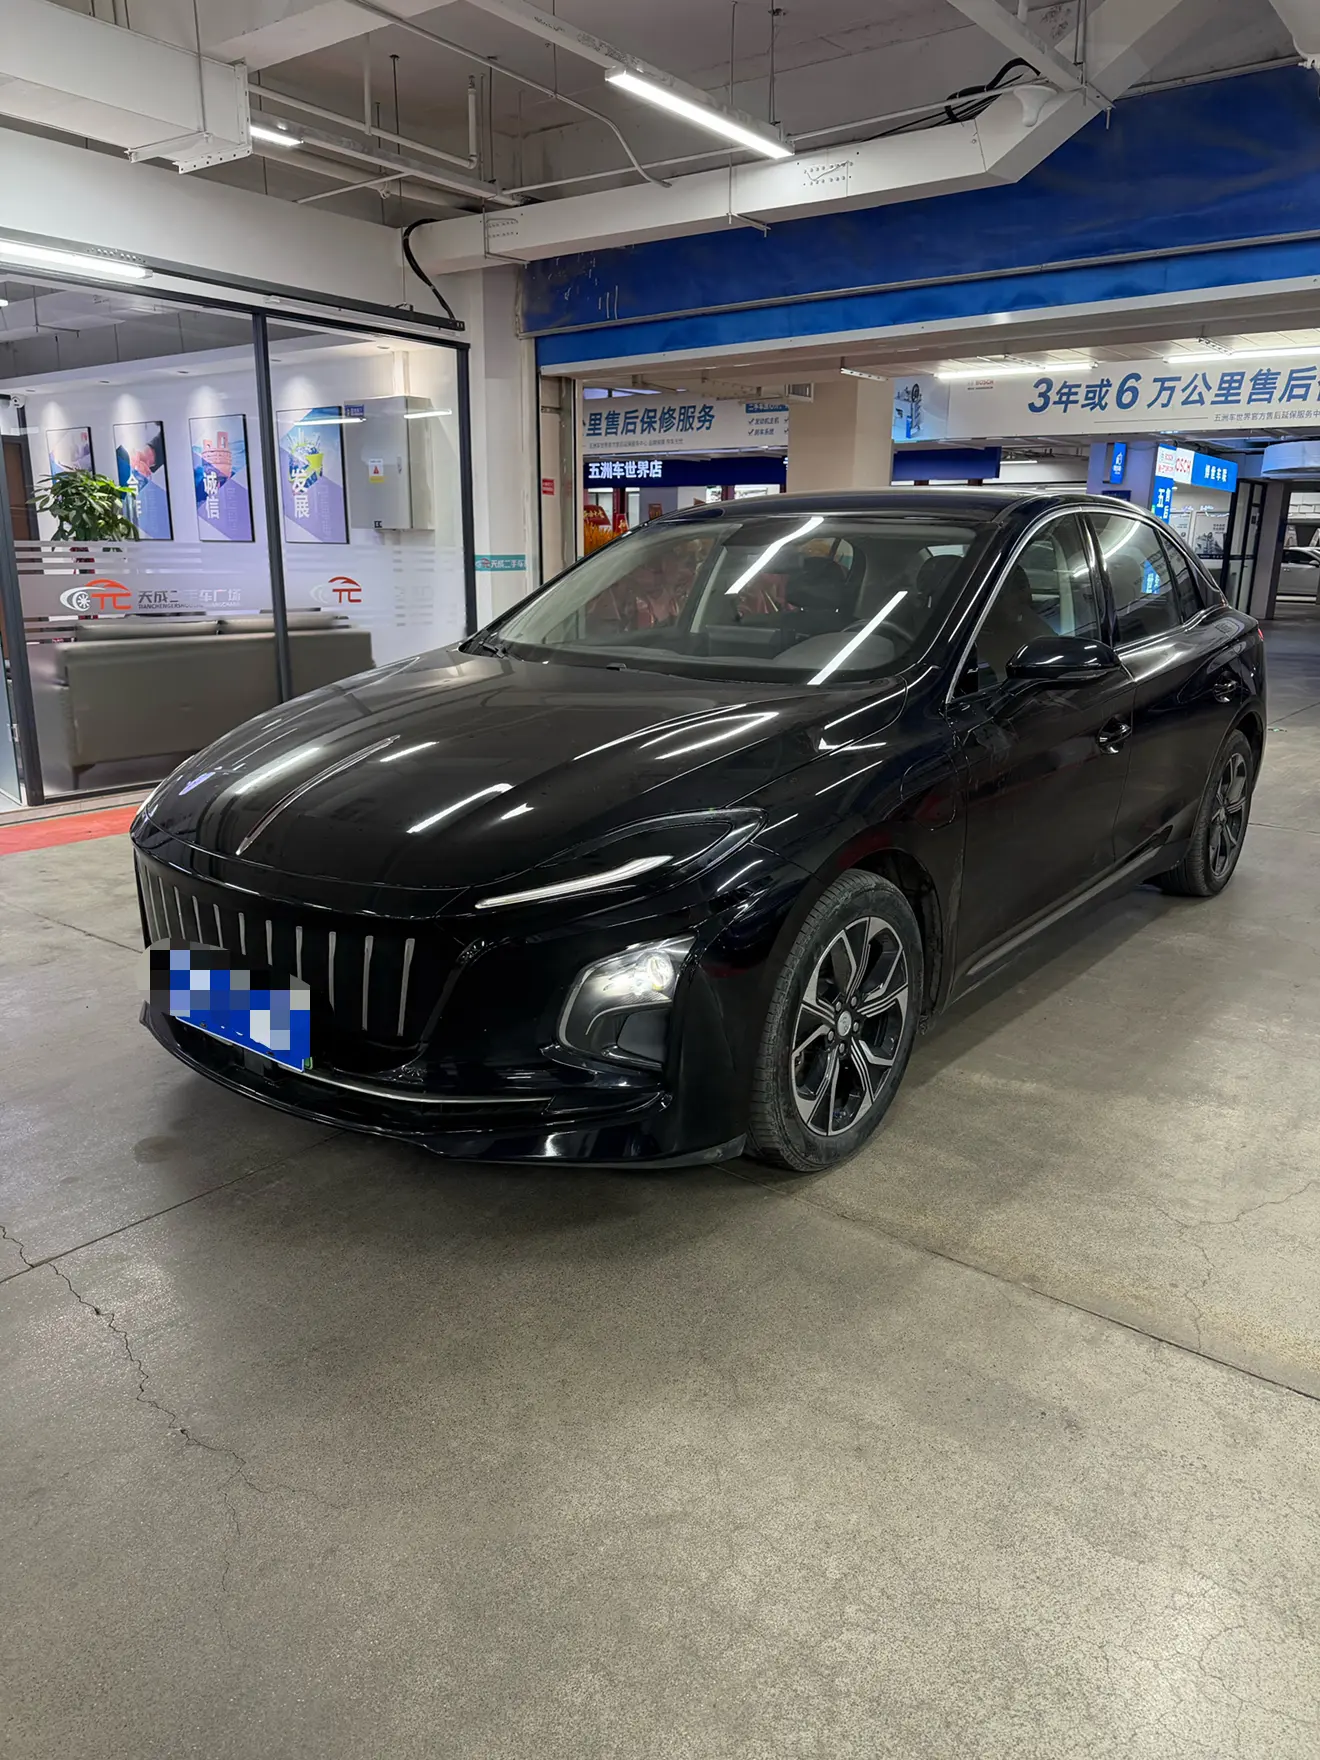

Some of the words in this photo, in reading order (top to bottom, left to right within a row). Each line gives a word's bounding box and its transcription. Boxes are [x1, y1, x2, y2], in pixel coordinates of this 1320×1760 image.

[1027, 365, 1320, 413] 3年或6万公里售后
[292, 468, 311, 519] 发展
[588, 460, 664, 479] 五洲车世界店
[203, 471, 220, 519] 诚信
[138, 589, 242, 604] 天成二手车广场
